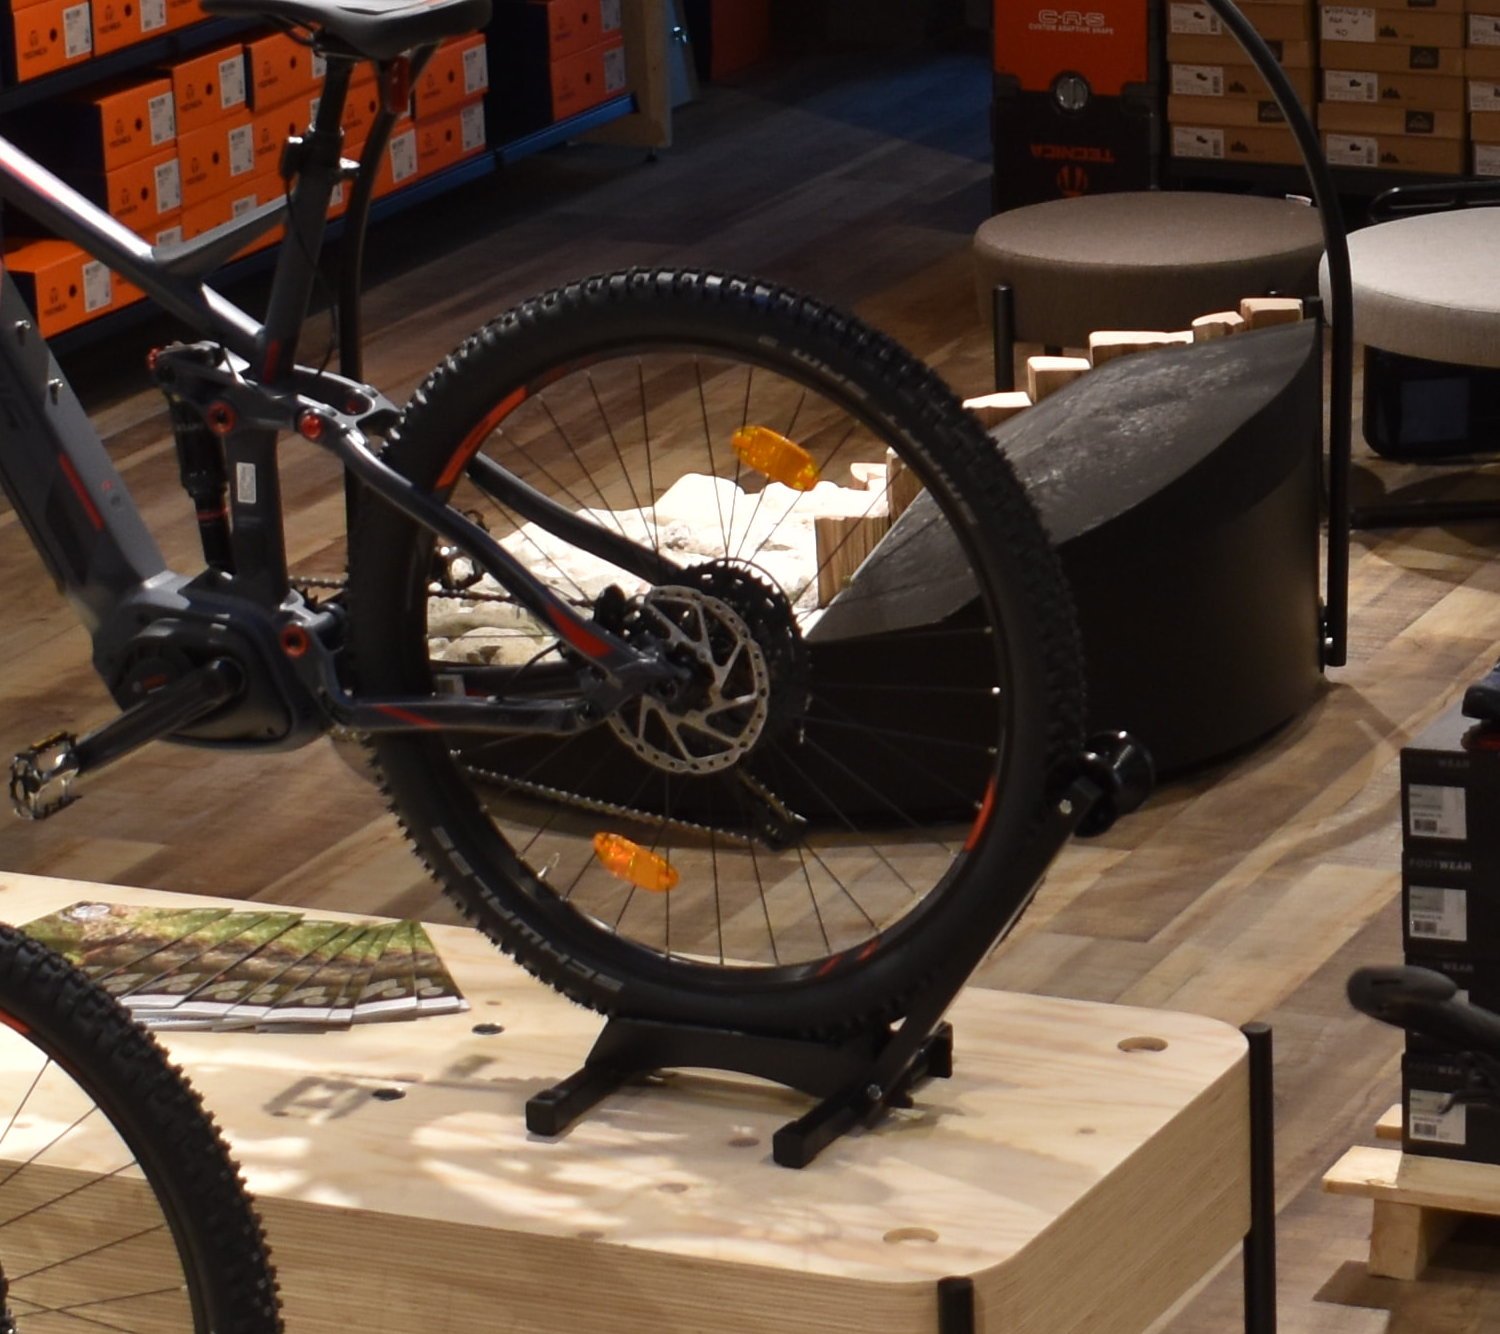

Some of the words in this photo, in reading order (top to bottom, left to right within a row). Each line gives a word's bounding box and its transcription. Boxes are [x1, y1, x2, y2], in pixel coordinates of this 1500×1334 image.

[1030, 144, 1116, 163] TECNICA
[1409, 858, 1472, 871] FOOTWEAR
[432, 827, 624, 991] SCHWALBE
